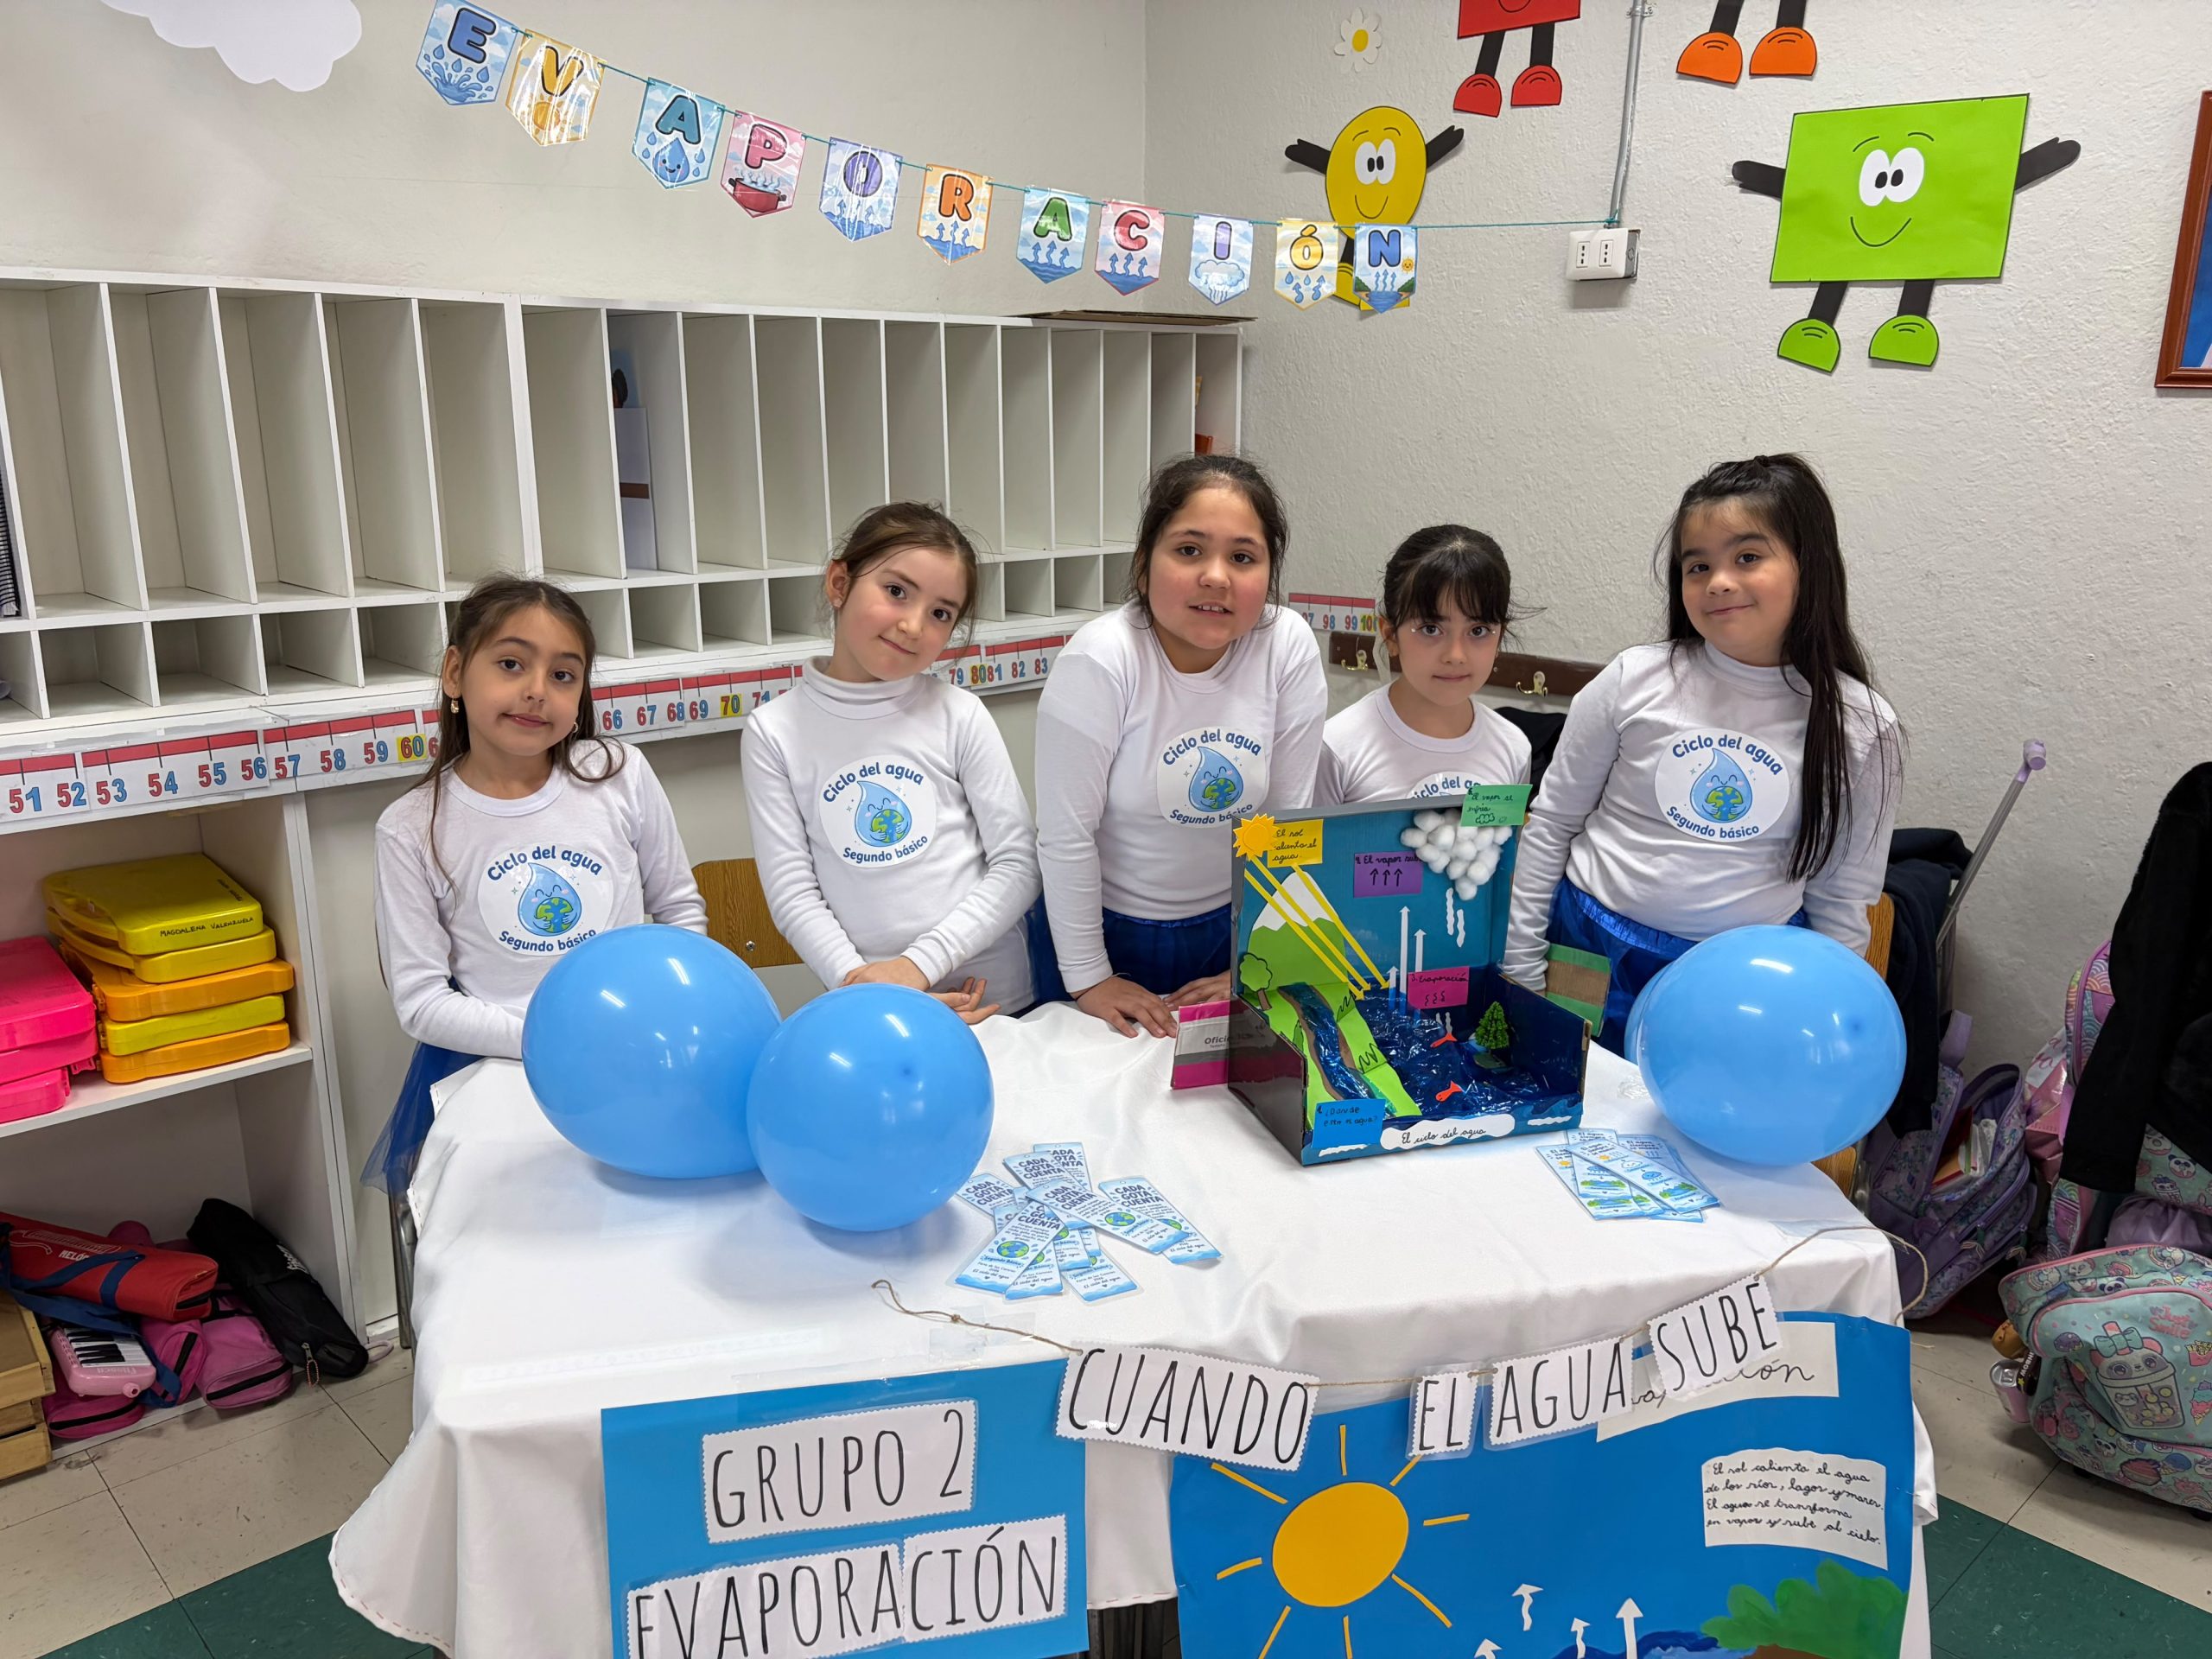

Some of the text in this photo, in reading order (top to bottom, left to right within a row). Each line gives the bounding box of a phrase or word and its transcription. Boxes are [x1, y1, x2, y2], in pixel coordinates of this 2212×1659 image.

[1323, 614, 1335, 630] 98
[1344, 615, 1357, 631] 99
[971, 664, 986, 684] 80
[987, 664, 1002, 683] 81
[1011, 660, 1026, 678] 82
[1034, 658, 1048, 675] 83
[602, 708, 624, 731] 66
[636, 704, 657, 727] 67
[667, 698, 685, 721] 68
[690, 698, 709, 721] 69
[721, 694, 741, 716] 70
[1163, 728, 1262, 766] Ciclo del agua
[1672, 734, 1783, 775] Ciclo del agua
[9, 786, 43, 815] 51
[56, 781, 87, 807] 52
[96, 779, 128, 805] 53
[148, 771, 179, 797] 54
[198, 761, 227, 788] 55
[241, 756, 268, 782] 56
[275, 753, 301, 779] 57
[320, 747, 346, 773] 58
[363, 738, 389, 764] 59
[401, 735, 423, 759] 60
[823, 762, 924, 803] Ciclo del agua
[1409, 783, 1439, 799] iclo
[1441, 776, 1460, 790] del
[1169, 804, 1253, 825] Segundo báico
[1667, 806, 1759, 839] Segundo básico
[1276, 829, 1286, 837] El
[842, 836, 928, 864] Segundo básico
[487, 845, 602, 880] Ciclo del agua
[160, 925, 206, 937] MAGDALENA
[499, 931, 554, 952] Segundo
[1402, 1127, 1486, 1144] El ciclo del agua
[1019, 1158, 1049, 1167] CADA
[1024, 1163, 1054, 1173] GOTA
[1023, 1168, 1065, 1179] CUENTA
[965, 1181, 995, 1193] CADA
[974, 1185, 1003, 1198] GOTA
[1045, 1185, 1071, 1198] CADA
[1115, 1185, 1146, 1194] CADA
[1122, 1191, 1153, 1199] GOTA
[1055, 1190, 1084, 1203] GOTA
[1061, 1192, 1096, 1210] CUENTA
[1121, 1196, 1164, 1207] CUENTA
[1018, 1216, 1061, 1230] CUENTA
[1069, 1282, 1777, 1464] CUANDO EL AGUA SUBE
[711, 1409, 963, 1529] GRUPO 2
[1713, 1459, 1870, 1484] El sol calienta el agua
[1704, 1484, 1719, 1494] de
[1722, 1478, 1742, 1491] los
[1788, 1478, 1827, 1496] lagos
[1707, 1497, 1853, 1520] El agua se transforma
[1707, 1518, 1720, 1528] en
[1726, 1516, 1762, 1528] vapor
[1766, 1517, 1783, 1529] y
[1782, 1516, 1816, 1529] sube
[1823, 1521, 1842, 1532] al
[635, 1526, 1057, 1659] EVAPORACIÓN
